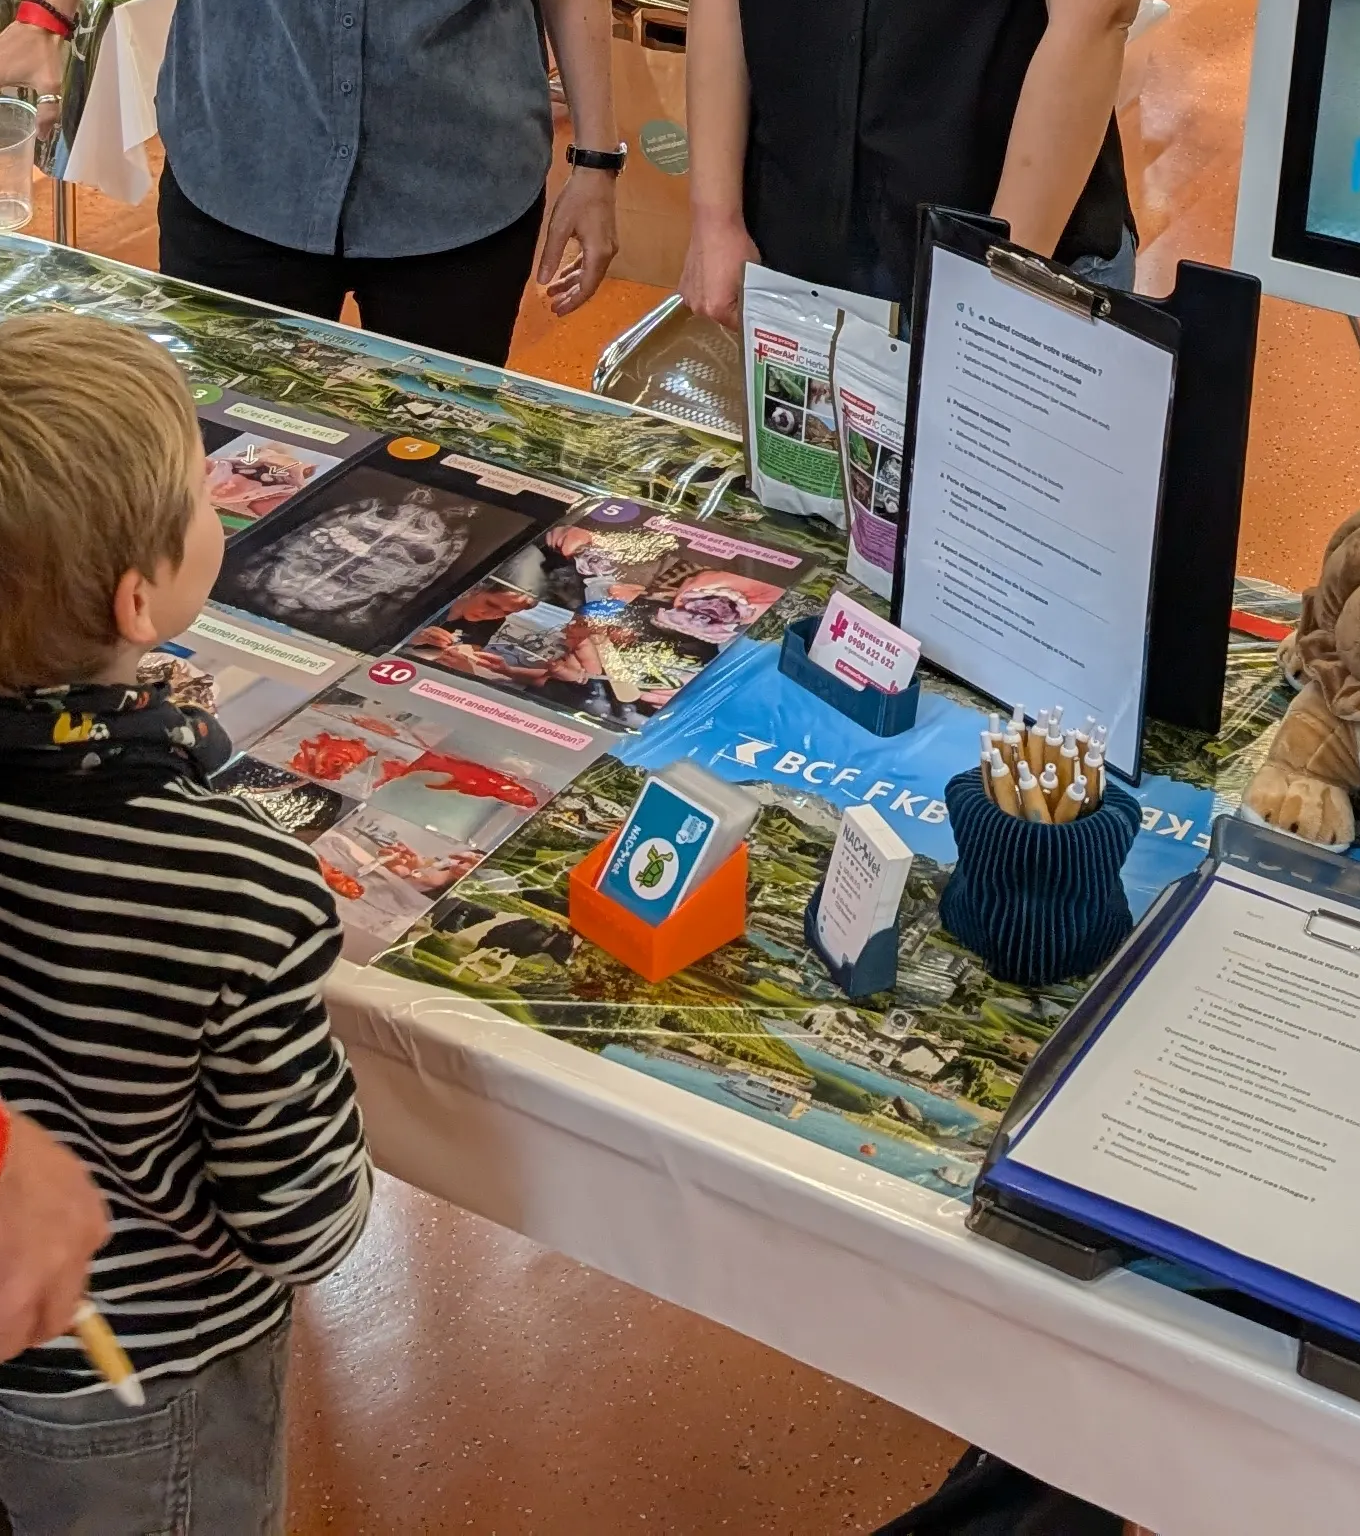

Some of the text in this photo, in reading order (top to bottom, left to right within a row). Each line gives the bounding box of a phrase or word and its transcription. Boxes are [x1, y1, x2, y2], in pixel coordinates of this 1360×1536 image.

[404, 443, 423, 453] 4
[602, 504, 625, 516] 5
[199, 620, 326, 671] examen complémentaire?
[852, 621, 885, 648] Urgences
[885, 642, 901, 657] NAC
[866, 646, 880, 661] 622
[880, 655, 895, 670] 622
[372, 663, 413, 682] 10
[418, 682, 585, 748] Comment anesthésier un poisson?
[773, 750, 949, 824] BCF FKB
[611, 824, 642, 875] NAC Vet
[843, 823, 861, 852] NAC
[867, 851, 882, 879] Vet
